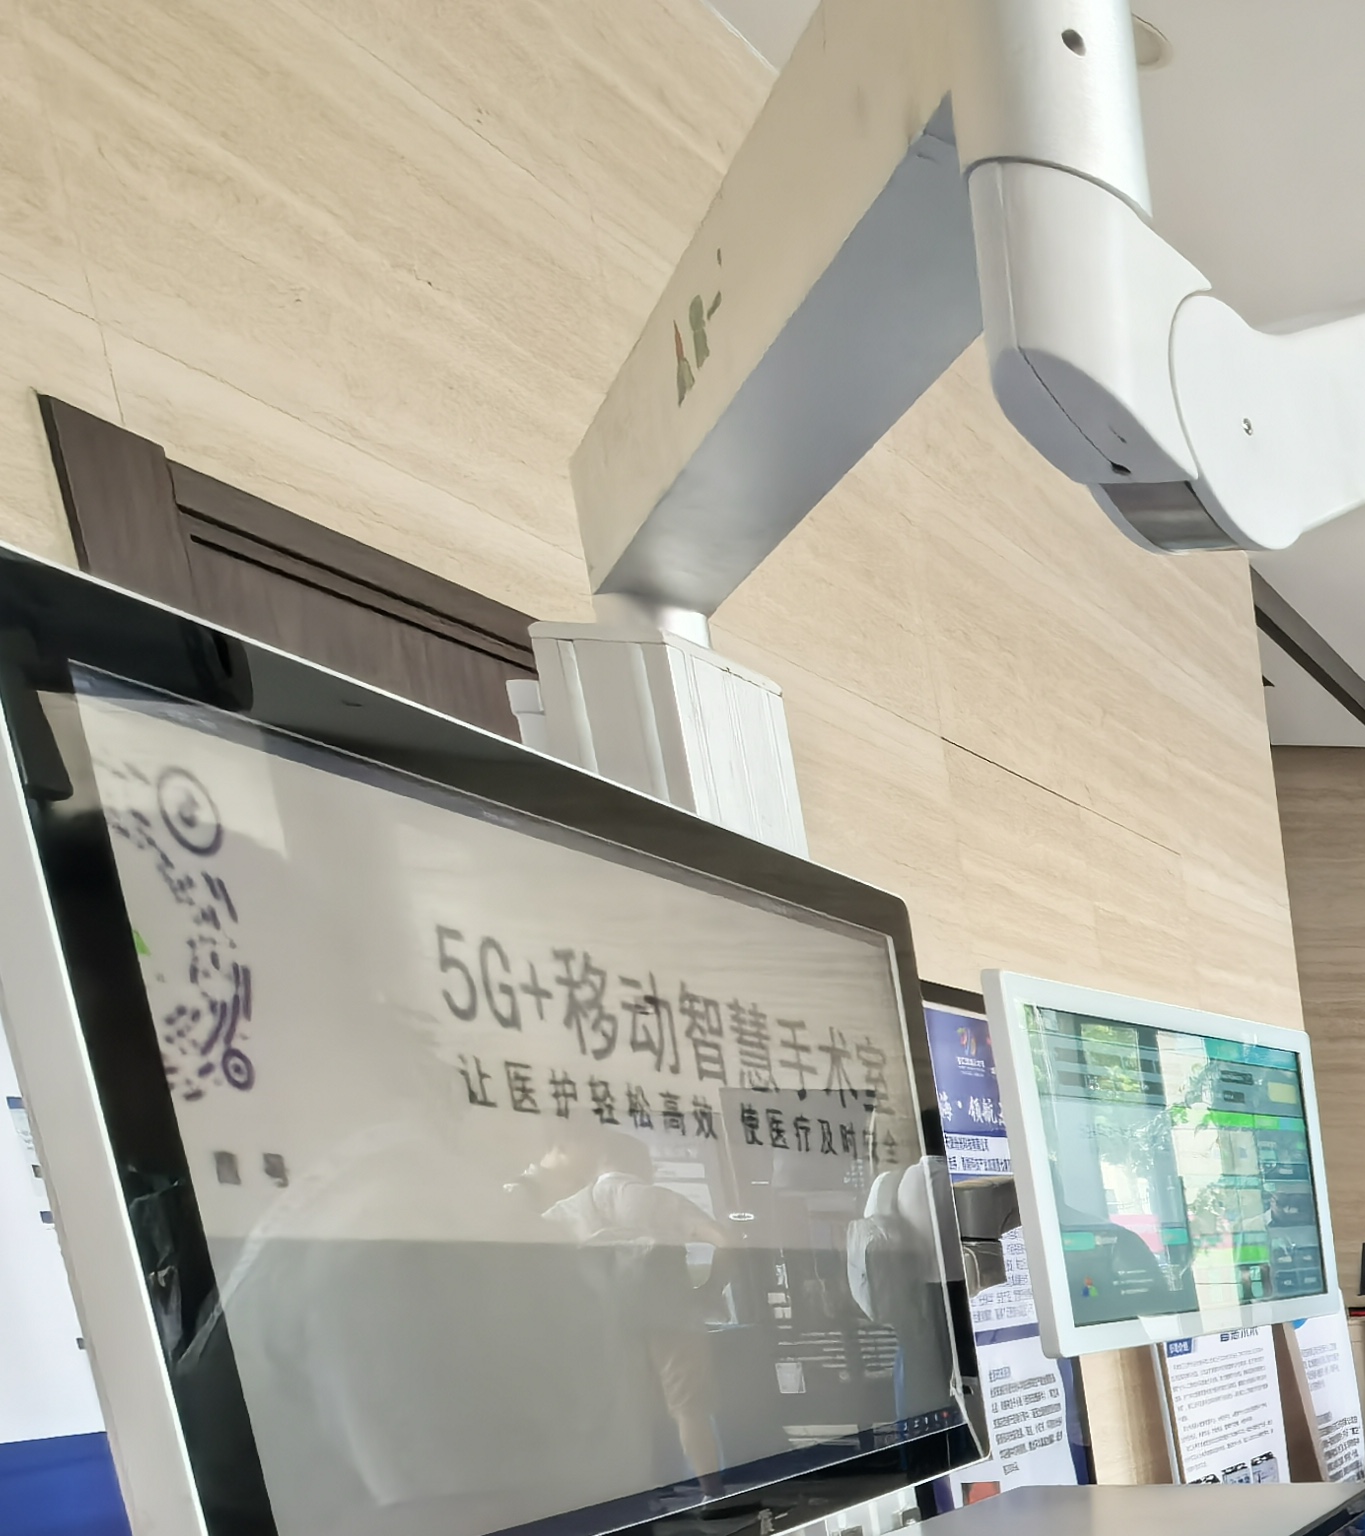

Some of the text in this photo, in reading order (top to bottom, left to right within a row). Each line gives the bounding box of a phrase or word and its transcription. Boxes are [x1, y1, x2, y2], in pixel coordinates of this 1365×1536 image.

[436, 925, 893, 1115] 5G+移动智慧手术室
[459, 1054, 718, 1140] 让医护轻松高效
